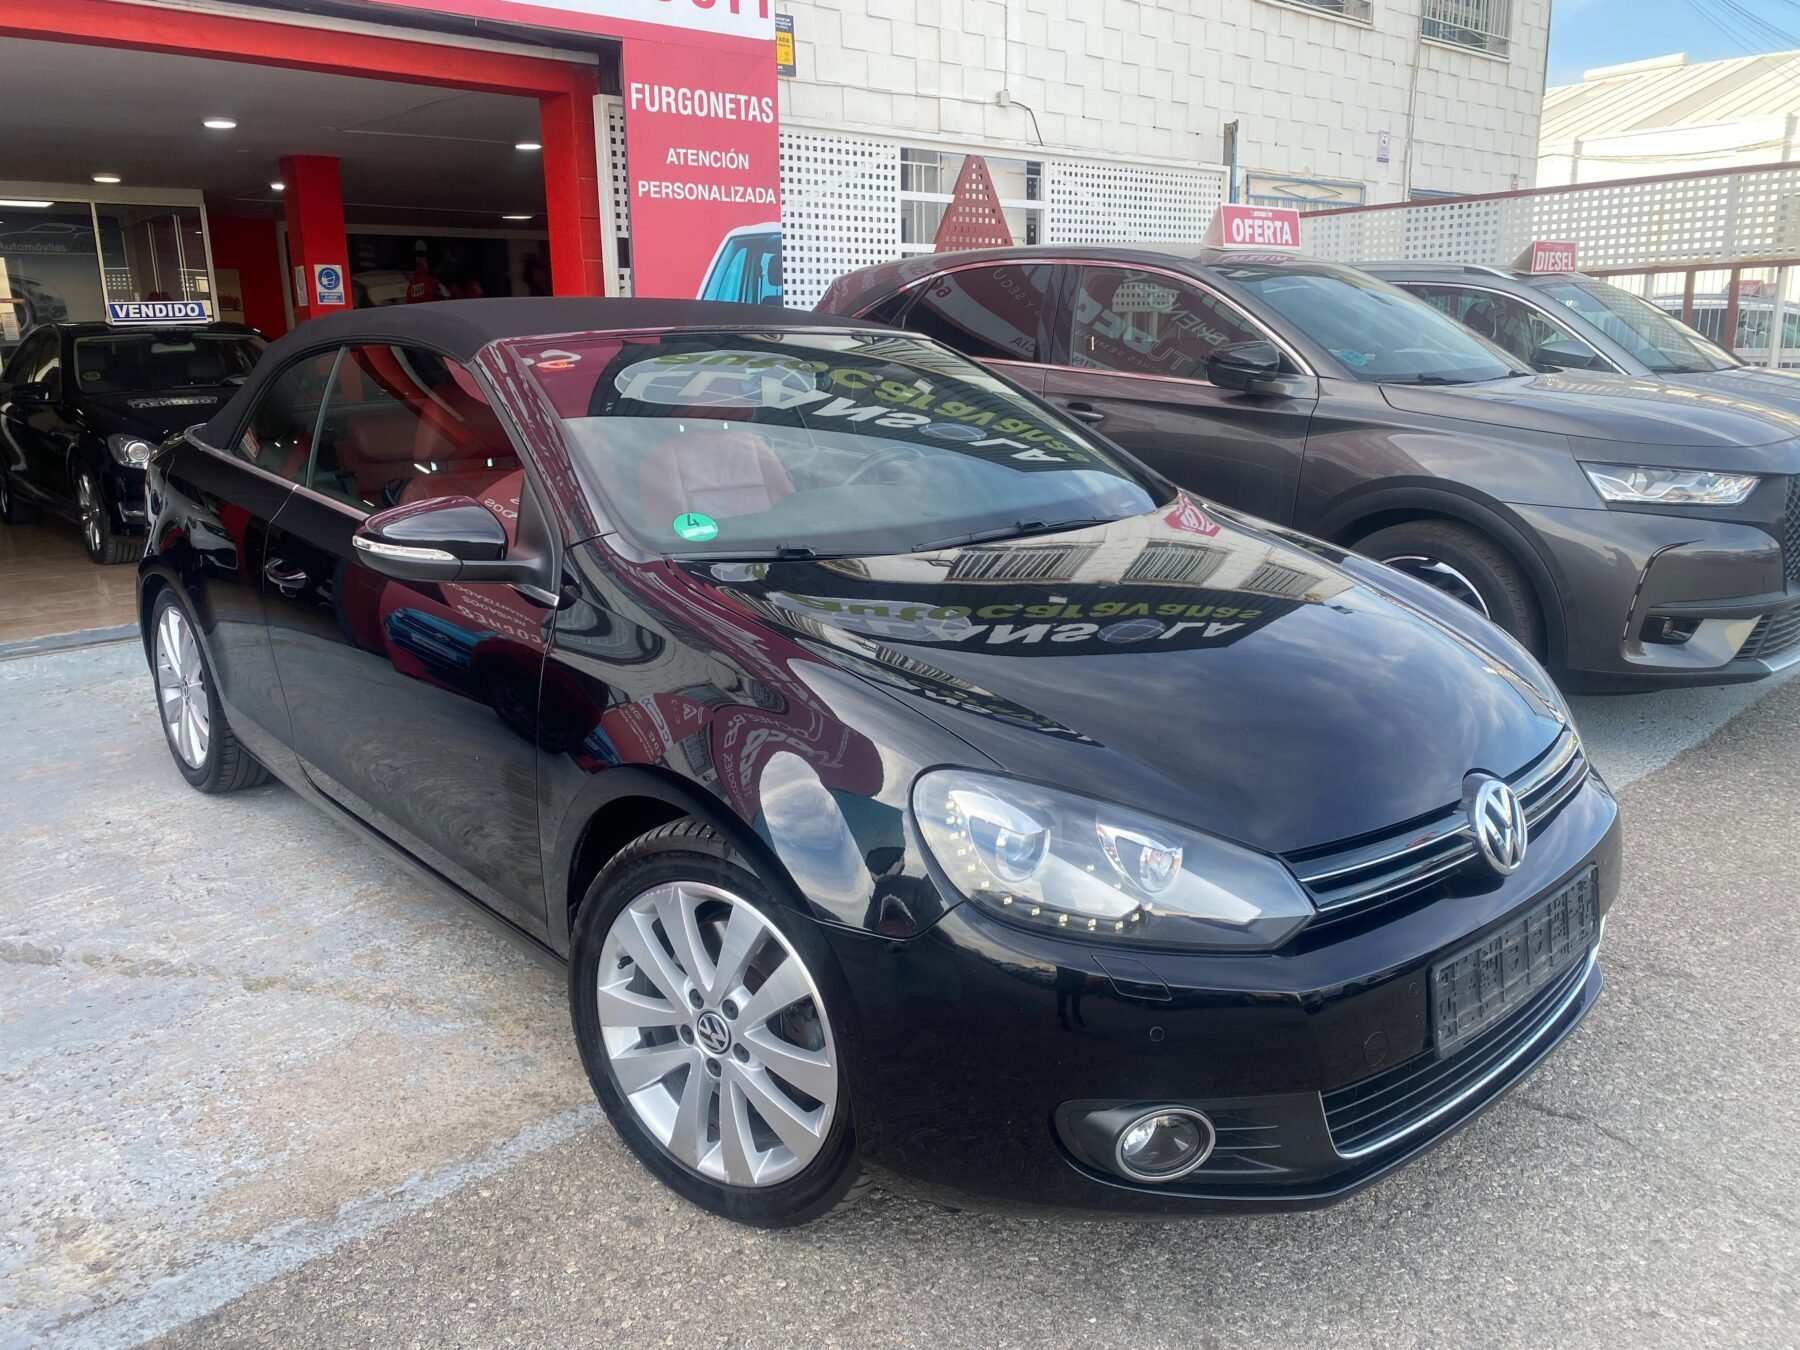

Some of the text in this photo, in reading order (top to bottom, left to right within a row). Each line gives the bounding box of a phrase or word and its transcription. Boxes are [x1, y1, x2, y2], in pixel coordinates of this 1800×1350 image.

[630, 82, 774, 124] FURGONETAS
[666, 148, 750, 170] ATENCIÓN
[637, 180, 777, 205] PERSONALIZADA
[1231, 217, 1293, 245] OFERTA
[1536, 251, 1574, 271] DIESEL
[114, 303, 200, 318] VENDIDO
[686, 513, 701, 527] 4
